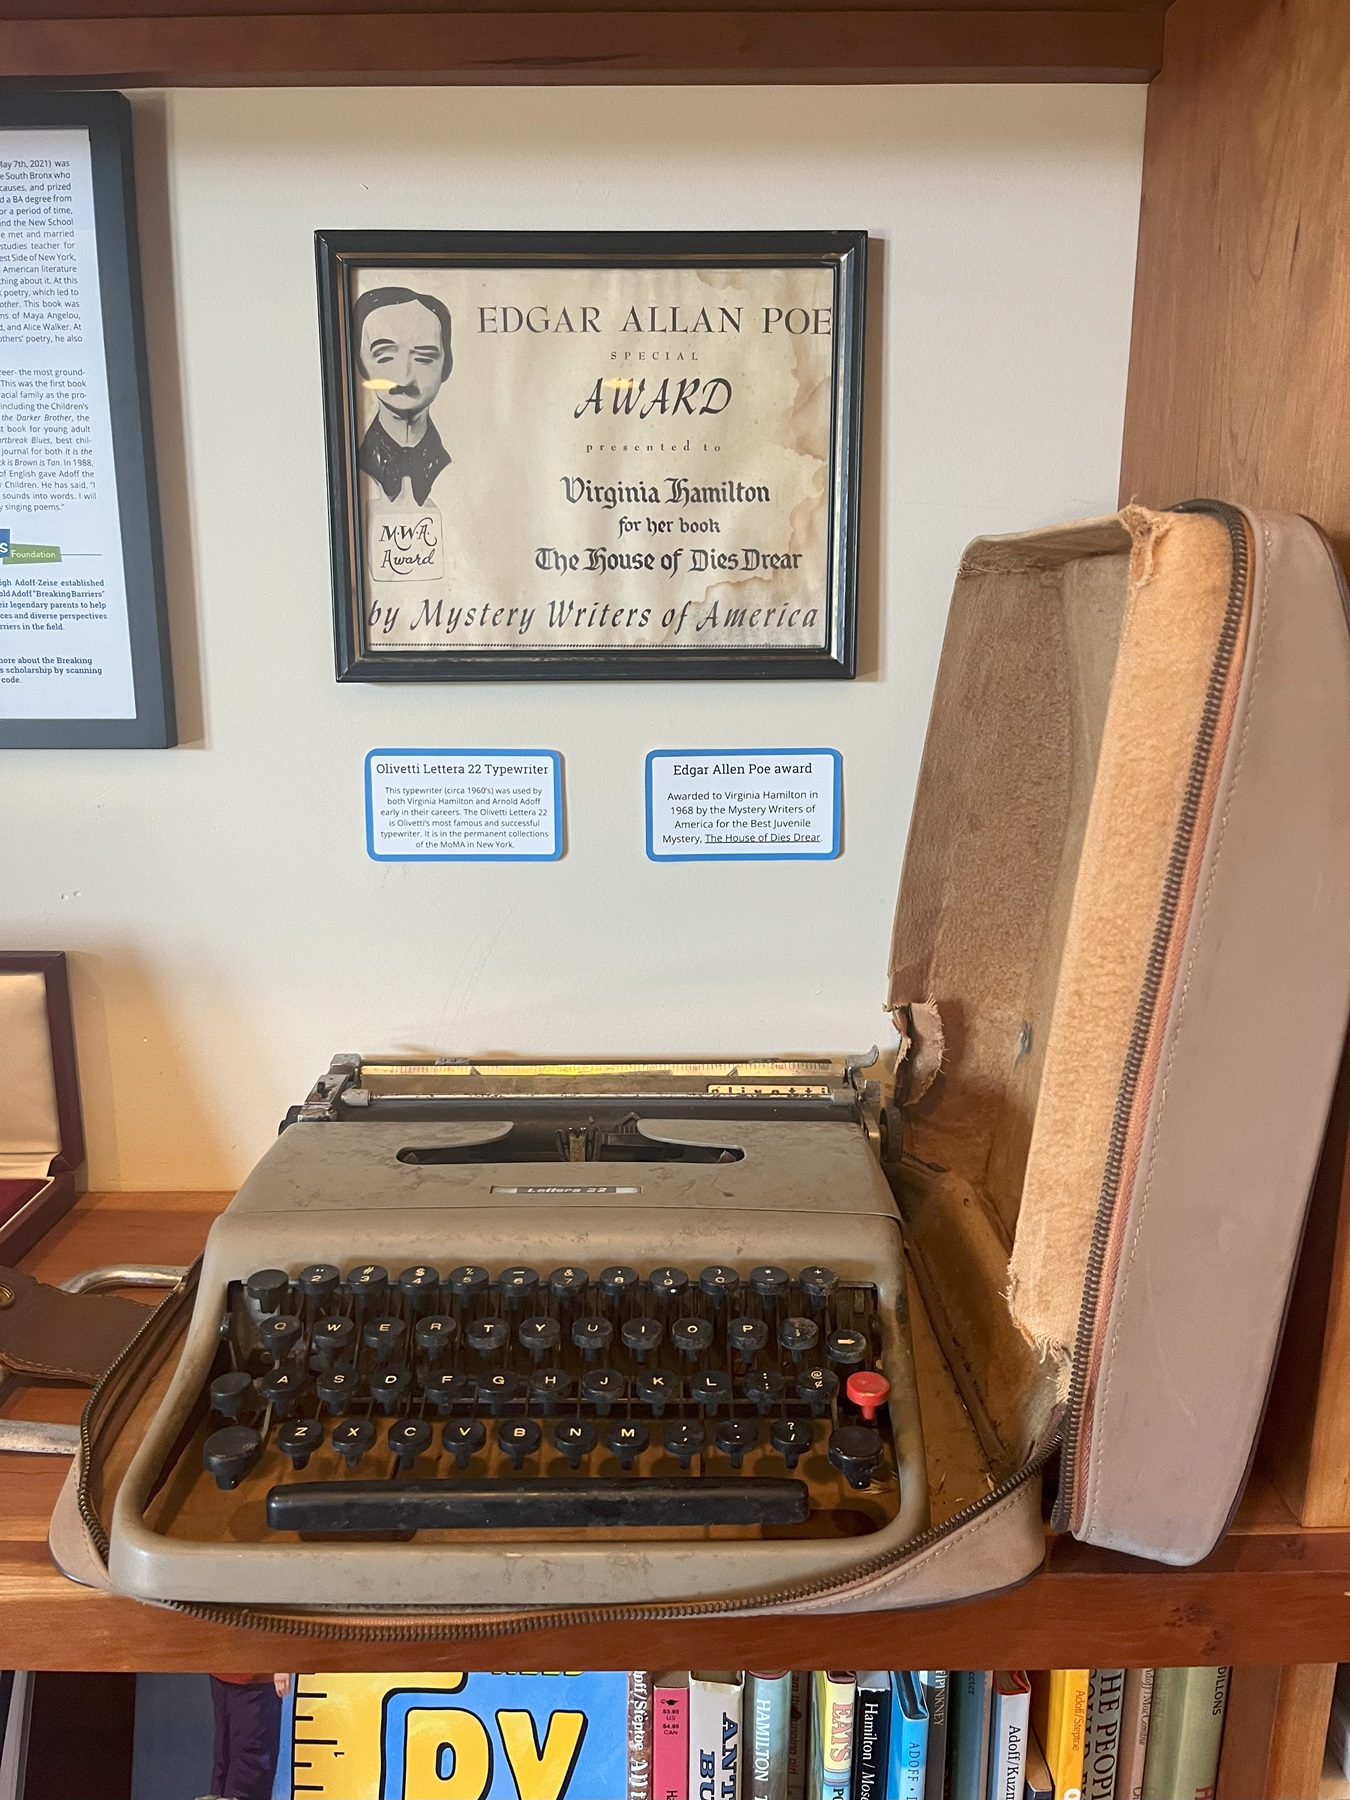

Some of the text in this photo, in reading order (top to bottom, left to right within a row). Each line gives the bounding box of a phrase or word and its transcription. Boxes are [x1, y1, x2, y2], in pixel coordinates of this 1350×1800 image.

[5, 172, 28, 180] South
[29, 218, 73, 226] New School
[477, 305, 832, 336] EDGAR ALLAN POE
[610, 351, 699, 361] SPECIAL
[574, 377, 732, 419] AWARD
[586, 441, 721, 453] presented to
[559, 476, 770, 509] Virginia Hamilton
[618, 517, 721, 538] for her book
[380, 548, 435, 575] Award
[534, 548, 802, 575] The House of Dies Drear
[10, 601, 48, 610] legendary
[50, 602, 79, 610] parents
[90, 601, 106, 610] help
[368, 599, 818, 631] by Mystery Writers of America
[56, 657, 92, 665] Breaking
[6, 666, 102, 676] scholarship scanning
[376, 763, 548, 776] Olivetti Lettera 22 Typewriter
[674, 763, 812, 777] Edgar Allen Poe award
[403, 787, 442, 796] typewriter
[444, 787, 465, 795] (circa
[533, 787, 542, 796] by
[667, 792, 709, 800] Awarded
[724, 791, 760, 802] Virginia
[763, 790, 806, 799] Hamilton
[407, 798, 436, 807] Virginia
[380, 809, 399, 817] early
[671, 804, 816, 816] 1968 by the Mystery Writers of
[501, 819, 540, 827] successful
[675, 820, 713, 829] America
[716, 819, 729, 828] for
[732, 820, 748, 828] the
[773, 819, 811, 829] Juvenile
[381, 830, 422, 839] typewriter.
[663, 833, 823, 845] Mystery, The House of Dies Drear.
[274, 1322, 287, 1331] Q
[379, 1324, 391, 1332] E
[430, 1323, 442, 1331] R
[483, 1324, 494, 1332] T
[535, 1324, 545, 1332] Y
[641, 1325, 645, 1333] I
[687, 1325, 697, 1333] O
[742, 1325, 753, 1333] P
[1213, 1667, 1226, 1716] DILLONS
[830, 1702, 853, 1762] EATS
[863, 1703, 878, 1760] Hamilton
[754, 1698, 771, 1781] HAMILTON
[907, 1742, 920, 1782] ADOFF
